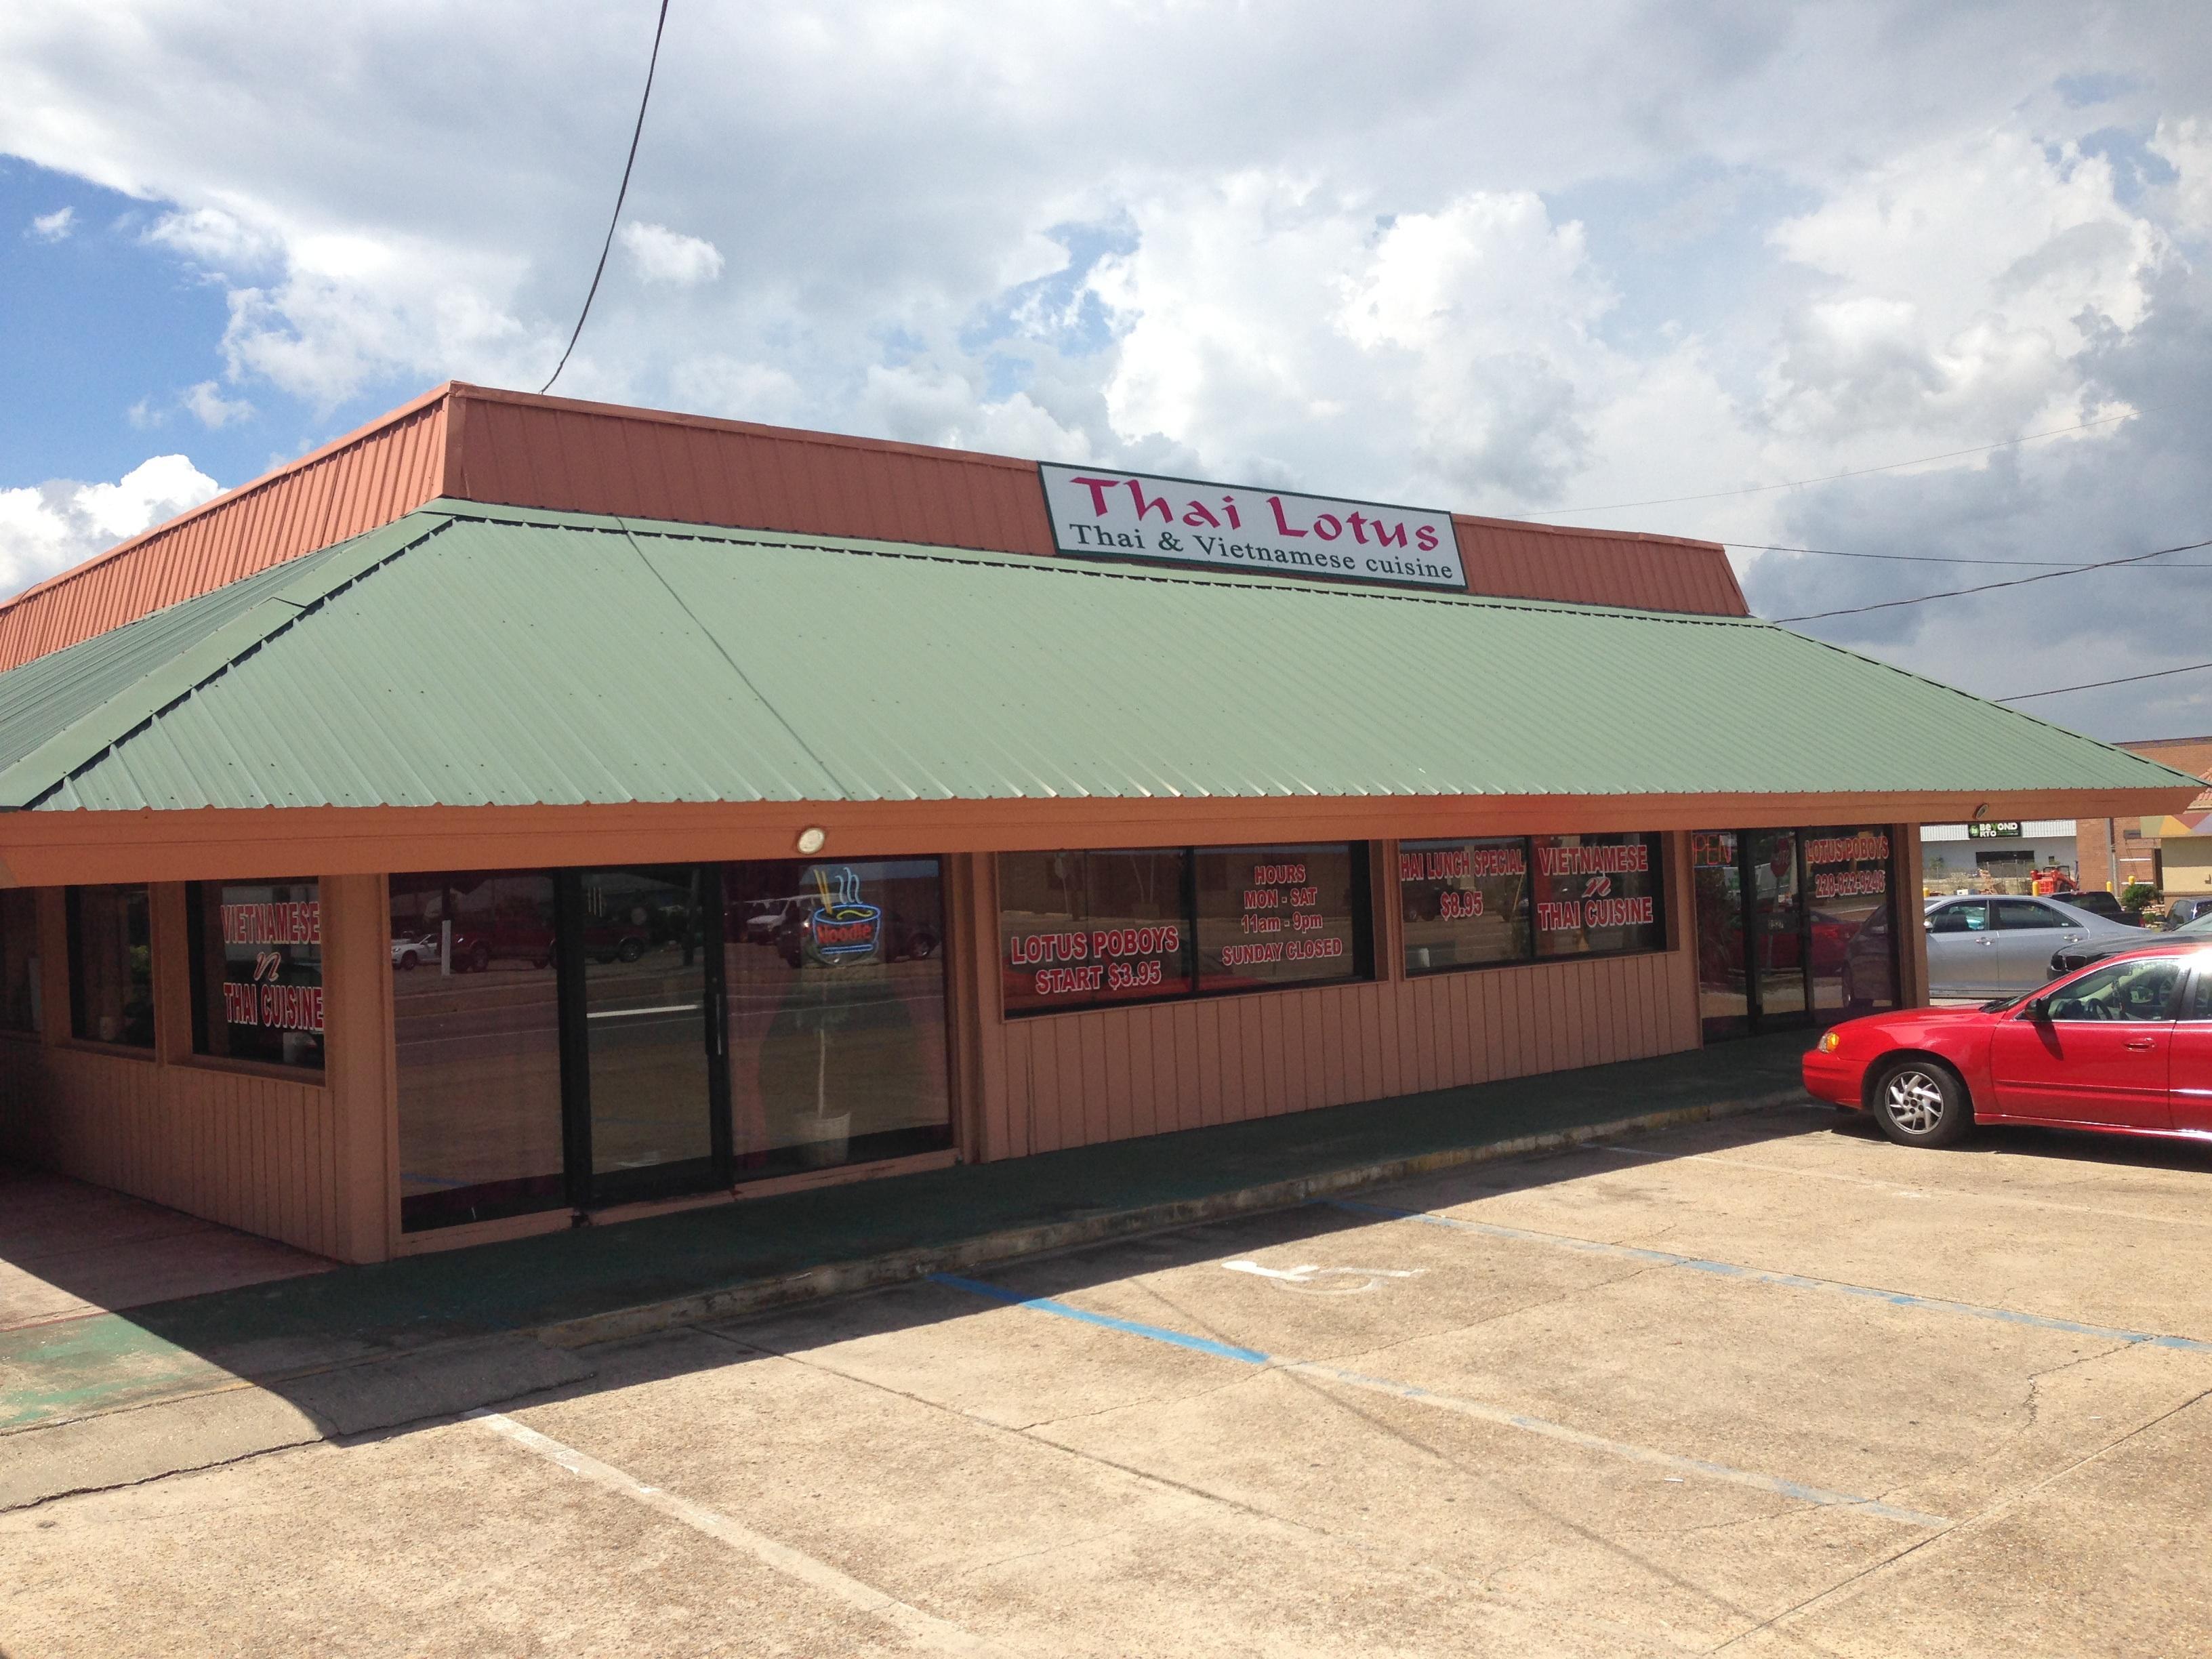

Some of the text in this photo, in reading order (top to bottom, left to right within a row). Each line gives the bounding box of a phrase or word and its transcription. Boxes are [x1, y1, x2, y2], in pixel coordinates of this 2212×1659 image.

[1070, 476, 1439, 551] Thai Lotus
[1069, 523, 1453, 579] Thai & Vietnamese cuisine
[1400, 848, 1526, 882] HAI LUNCH SPECIAL
[1538, 844, 1649, 876] VIETNAMESE
[1692, 834, 1732, 866] PEN
[1805, 836, 1889, 864] LOTUS POBOYS
[1254, 863, 1307, 885] HOURS
[1244, 889, 1278, 909] MON
[1290, 887, 1317, 907] SAT
[1440, 891, 1483, 922] $8.95
[1537, 897, 1654, 931] THAI CUISINE
[220, 901, 321, 944] VIETNAMESE
[817, 922, 873, 944] Noodle
[1240, 914, 1281, 933] 11am
[1292, 911, 1324, 934] 9pm
[1011, 925, 1179, 964] LOTUS POBOYS
[1222, 937, 1343, 966] SUNDAY CLOSED
[253, 951, 282, 982] n
[1036, 960, 1162, 995] START $3.95
[223, 982, 324, 1031] THAI CUISINE
